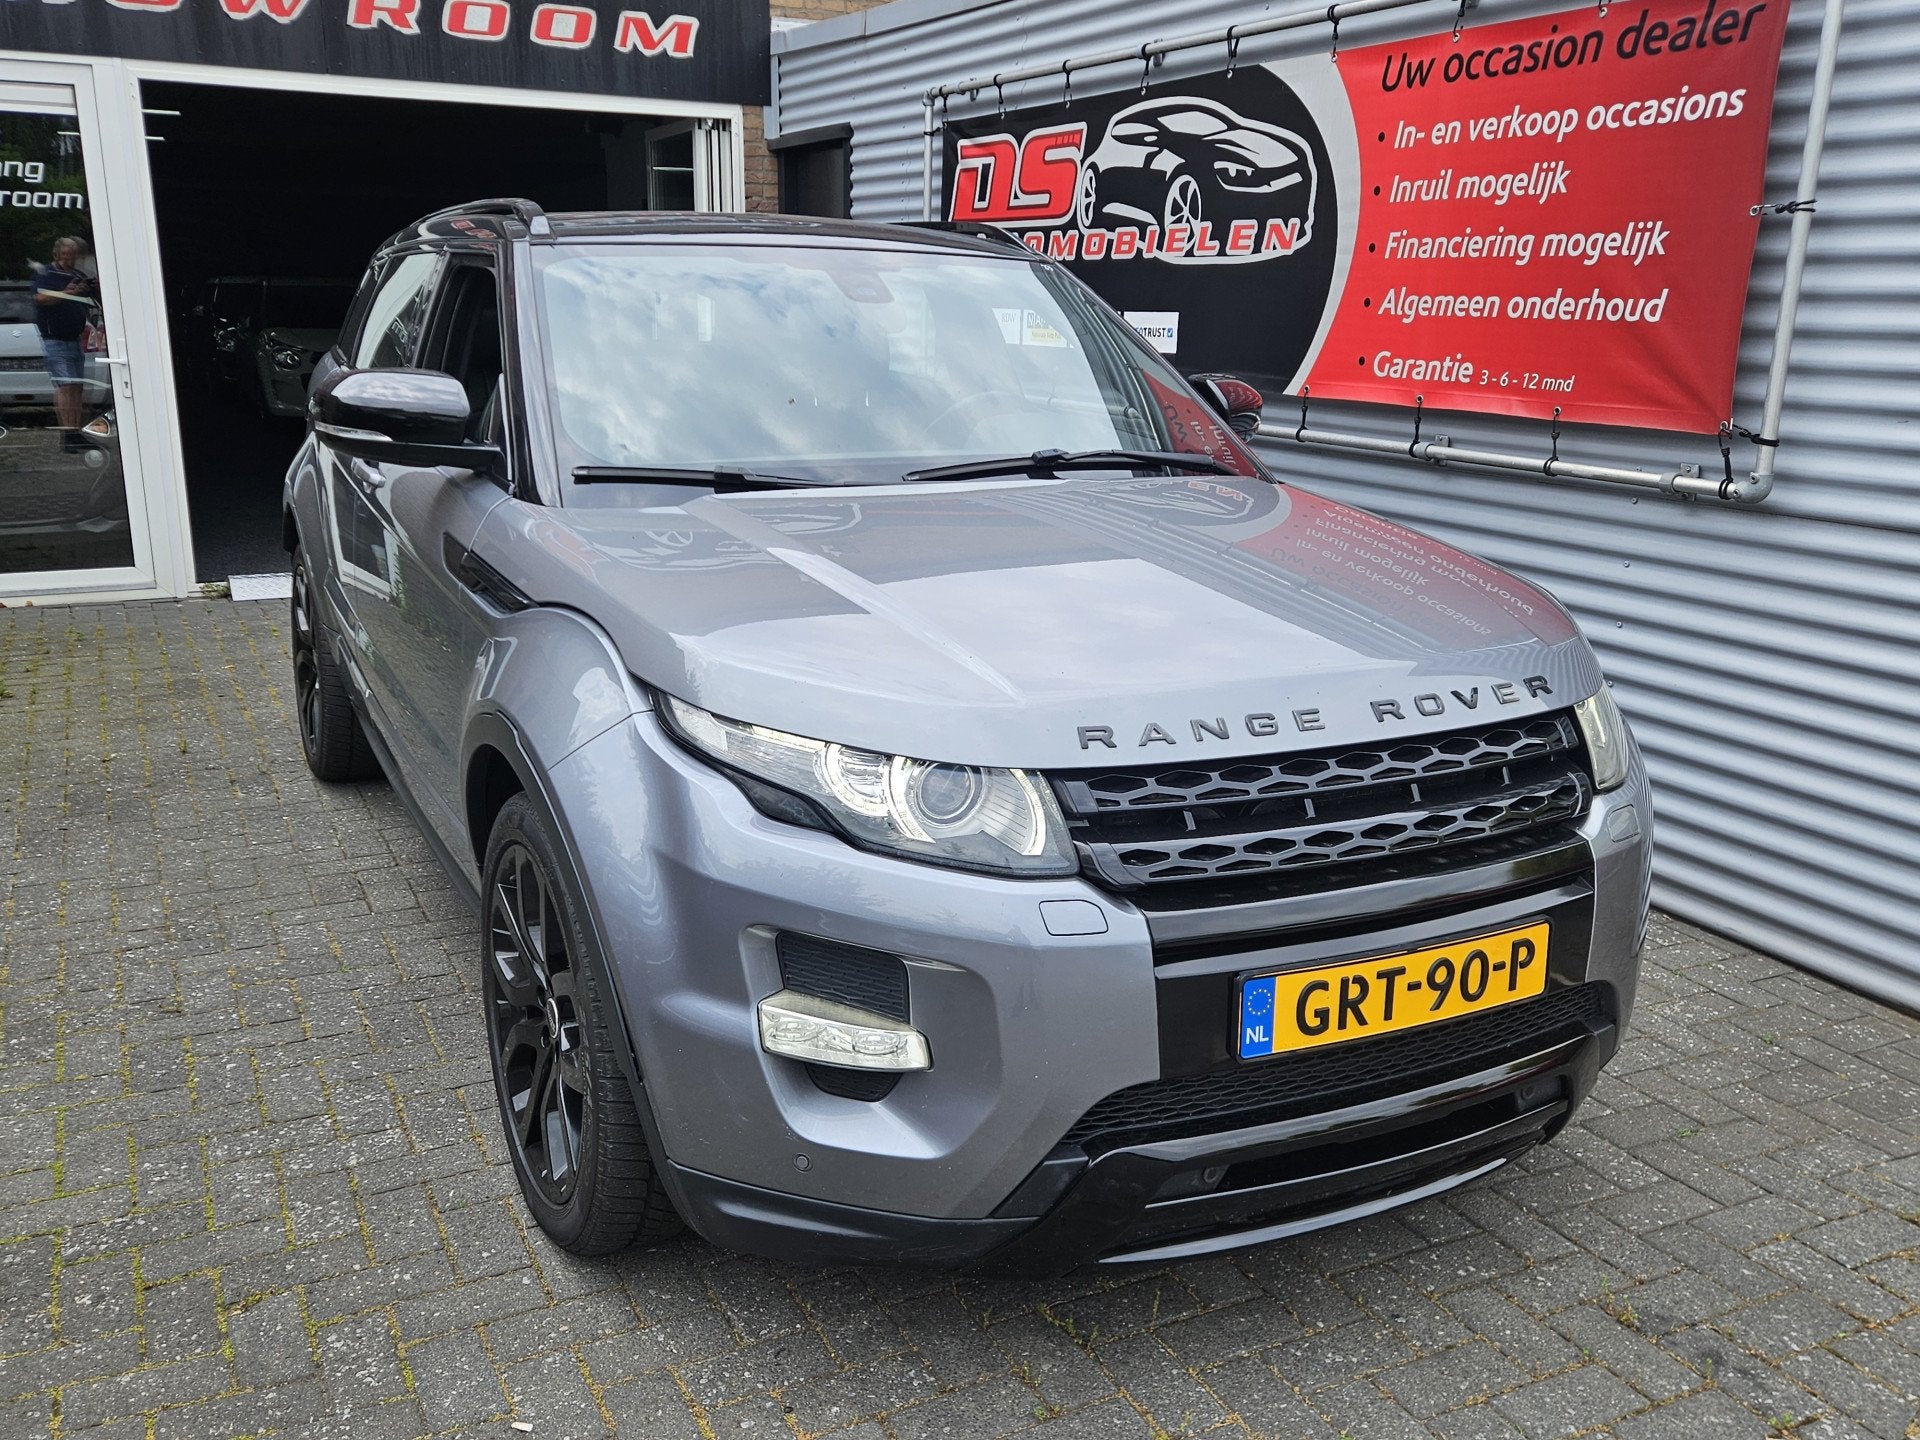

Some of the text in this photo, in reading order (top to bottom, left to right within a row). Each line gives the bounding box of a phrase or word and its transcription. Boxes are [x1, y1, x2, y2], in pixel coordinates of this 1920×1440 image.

[1381, 0, 1767, 93] Uw occasion dealer
[1393, 85, 1748, 149] In- en verkoop occasions
[0, 160, 45, 183] ng
[949, 122, 1087, 226] DS
[1389, 160, 1571, 207] Inruil mogelijk
[1008, 217, 1302, 261] OMOBIELEN
[1384, 220, 1671, 267] Financiering mogelijk
[1378, 286, 1669, 324] Algemeen onderhoud
[1136, 327, 1167, 338] OTRUST
[1373, 350, 1473, 384] Garantie
[1479, 370, 1489, 386] 3
[1499, 371, 1510, 387] 6
[1523, 372, 1538, 389] 12
[1541, 374, 1576, 392] mnd
[1077, 675, 1554, 750] RANGE ROVER
[1296, 937, 1536, 1036] GRT-90-P
[1245, 1026, 1269, 1045] NL
